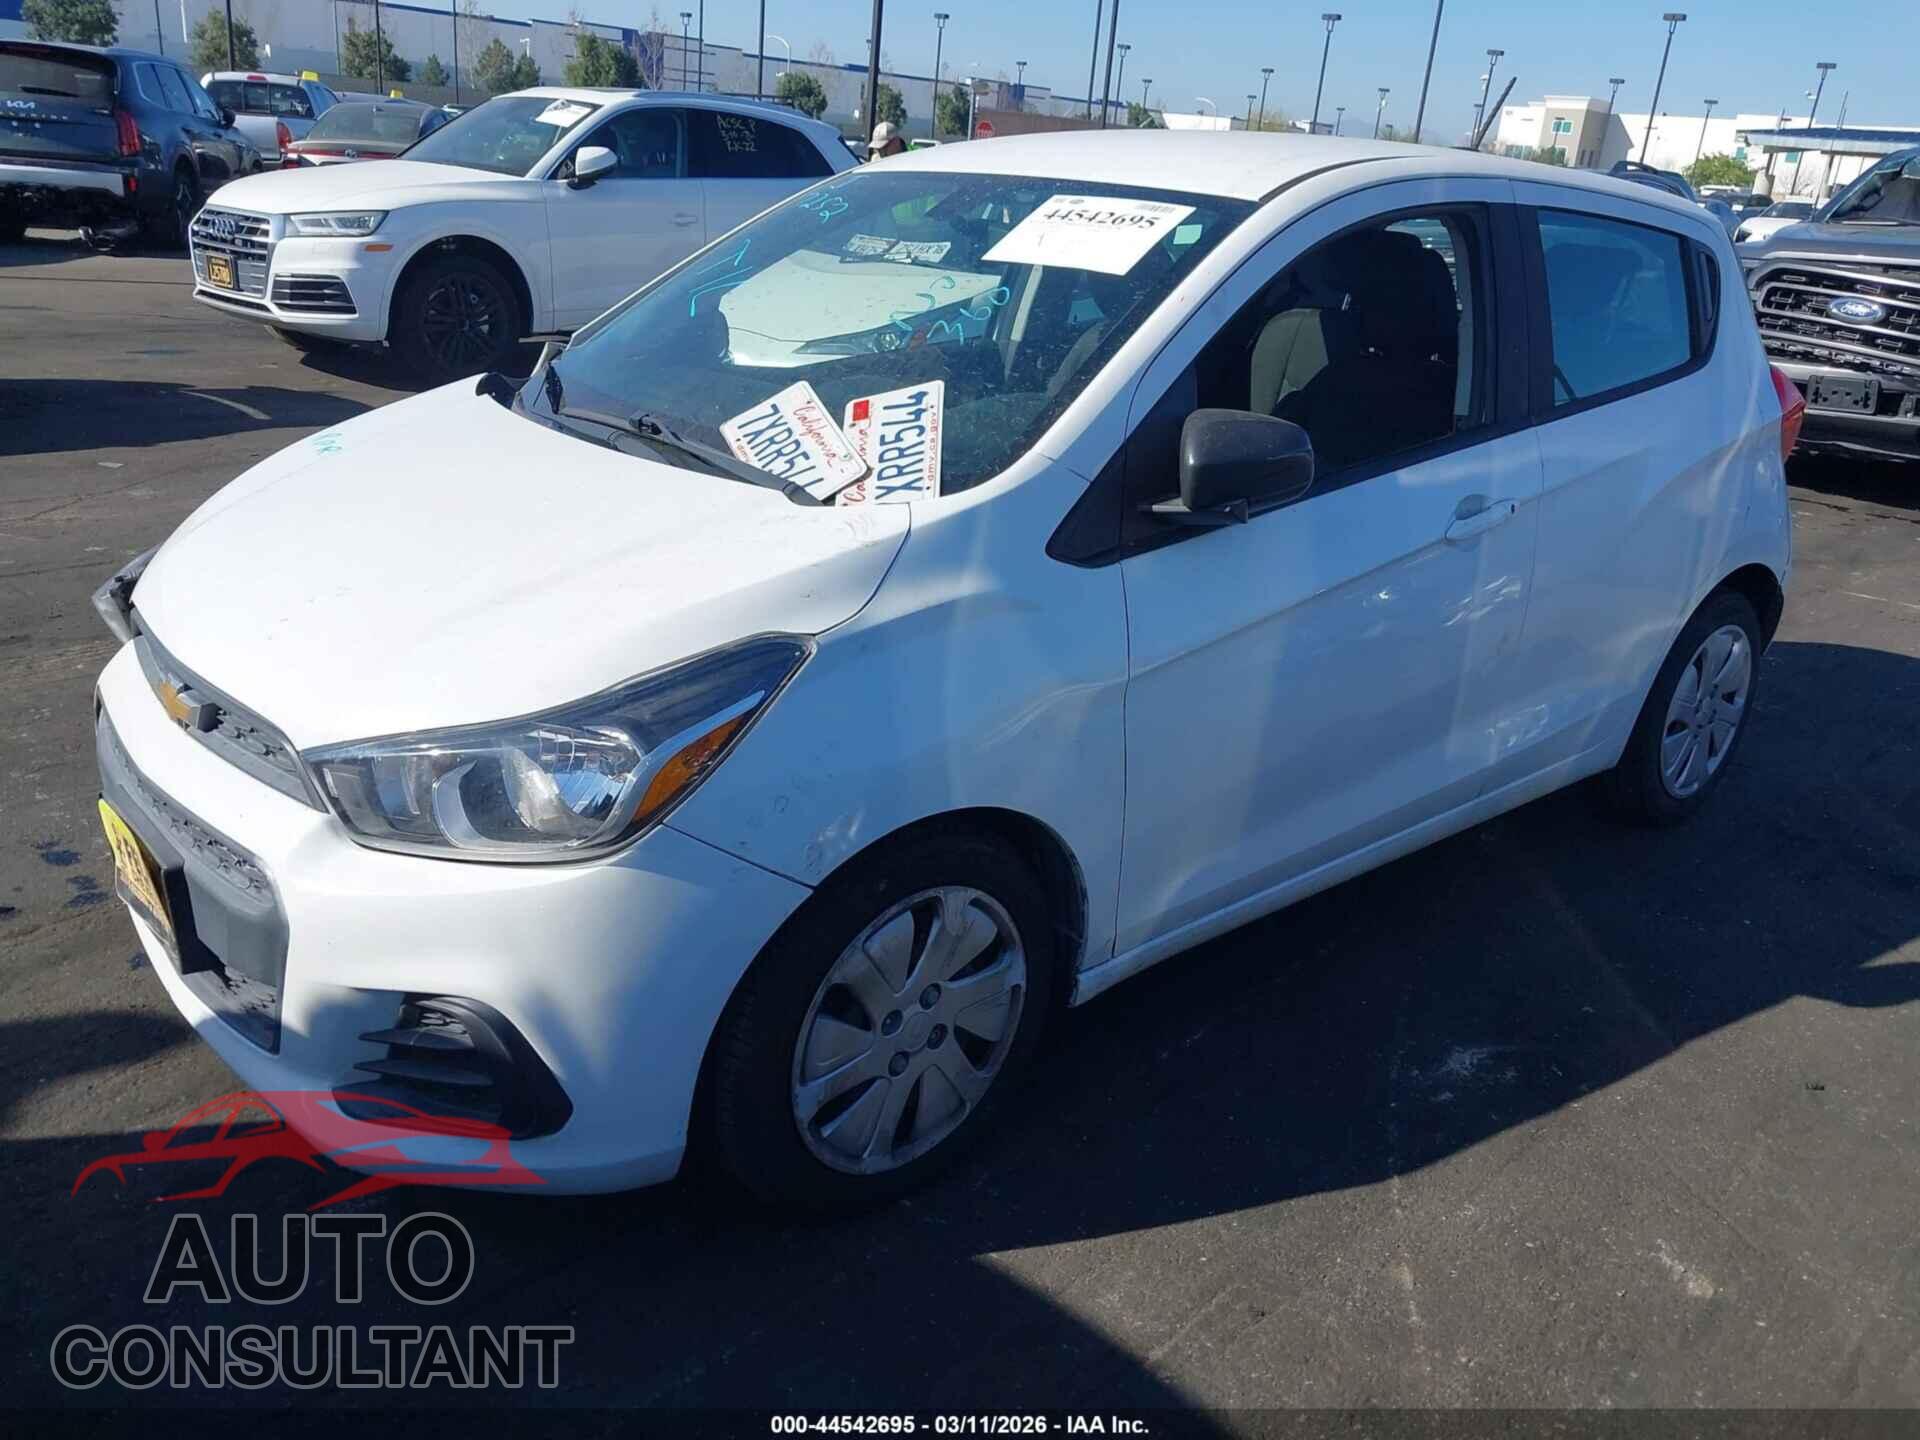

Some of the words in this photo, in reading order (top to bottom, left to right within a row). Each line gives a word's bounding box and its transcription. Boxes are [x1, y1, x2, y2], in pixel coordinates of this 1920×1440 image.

[1043, 208, 1161, 230] 44542695
[793, 405, 836, 468] California
[874, 390, 929, 500] XRR544
